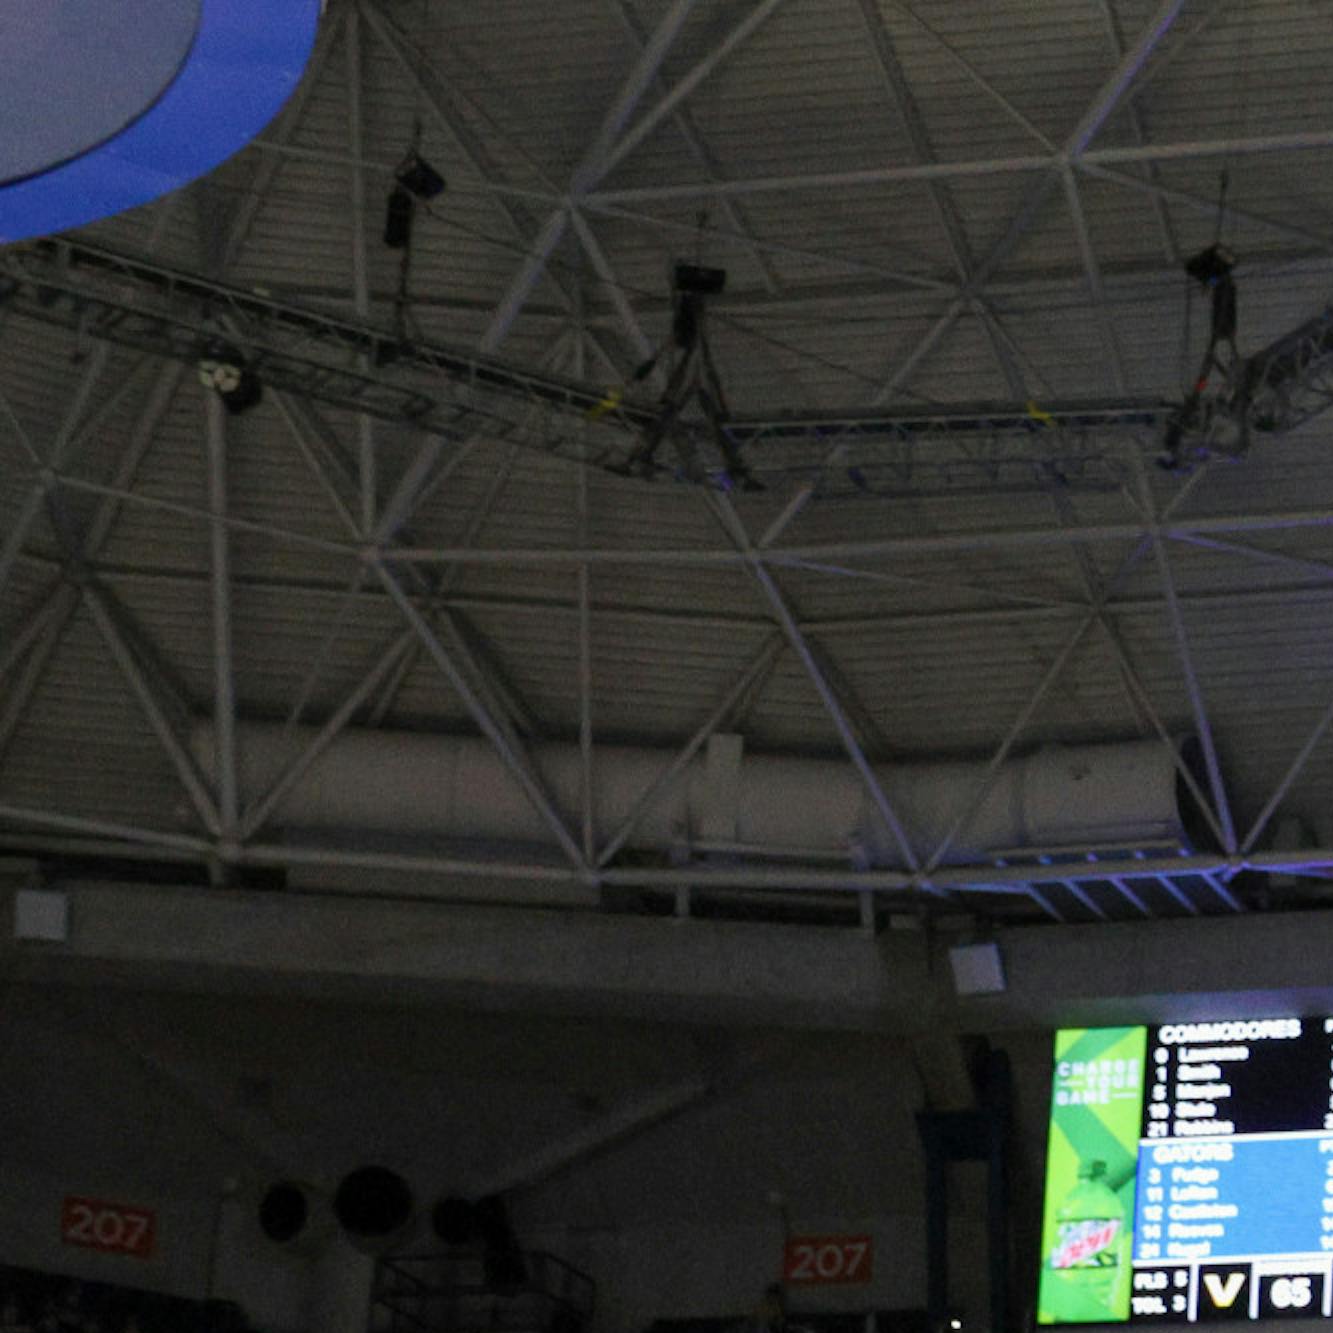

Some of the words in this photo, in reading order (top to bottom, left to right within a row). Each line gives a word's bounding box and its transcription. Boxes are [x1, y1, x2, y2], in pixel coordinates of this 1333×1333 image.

[1160, 1019, 1301, 1044] COMMODORES
[65, 1204, 147, 1249] 207
[790, 1242, 868, 1279] 207
[1204, 1273, 1245, 1306] V
[1271, 1277, 1311, 1307] 65
